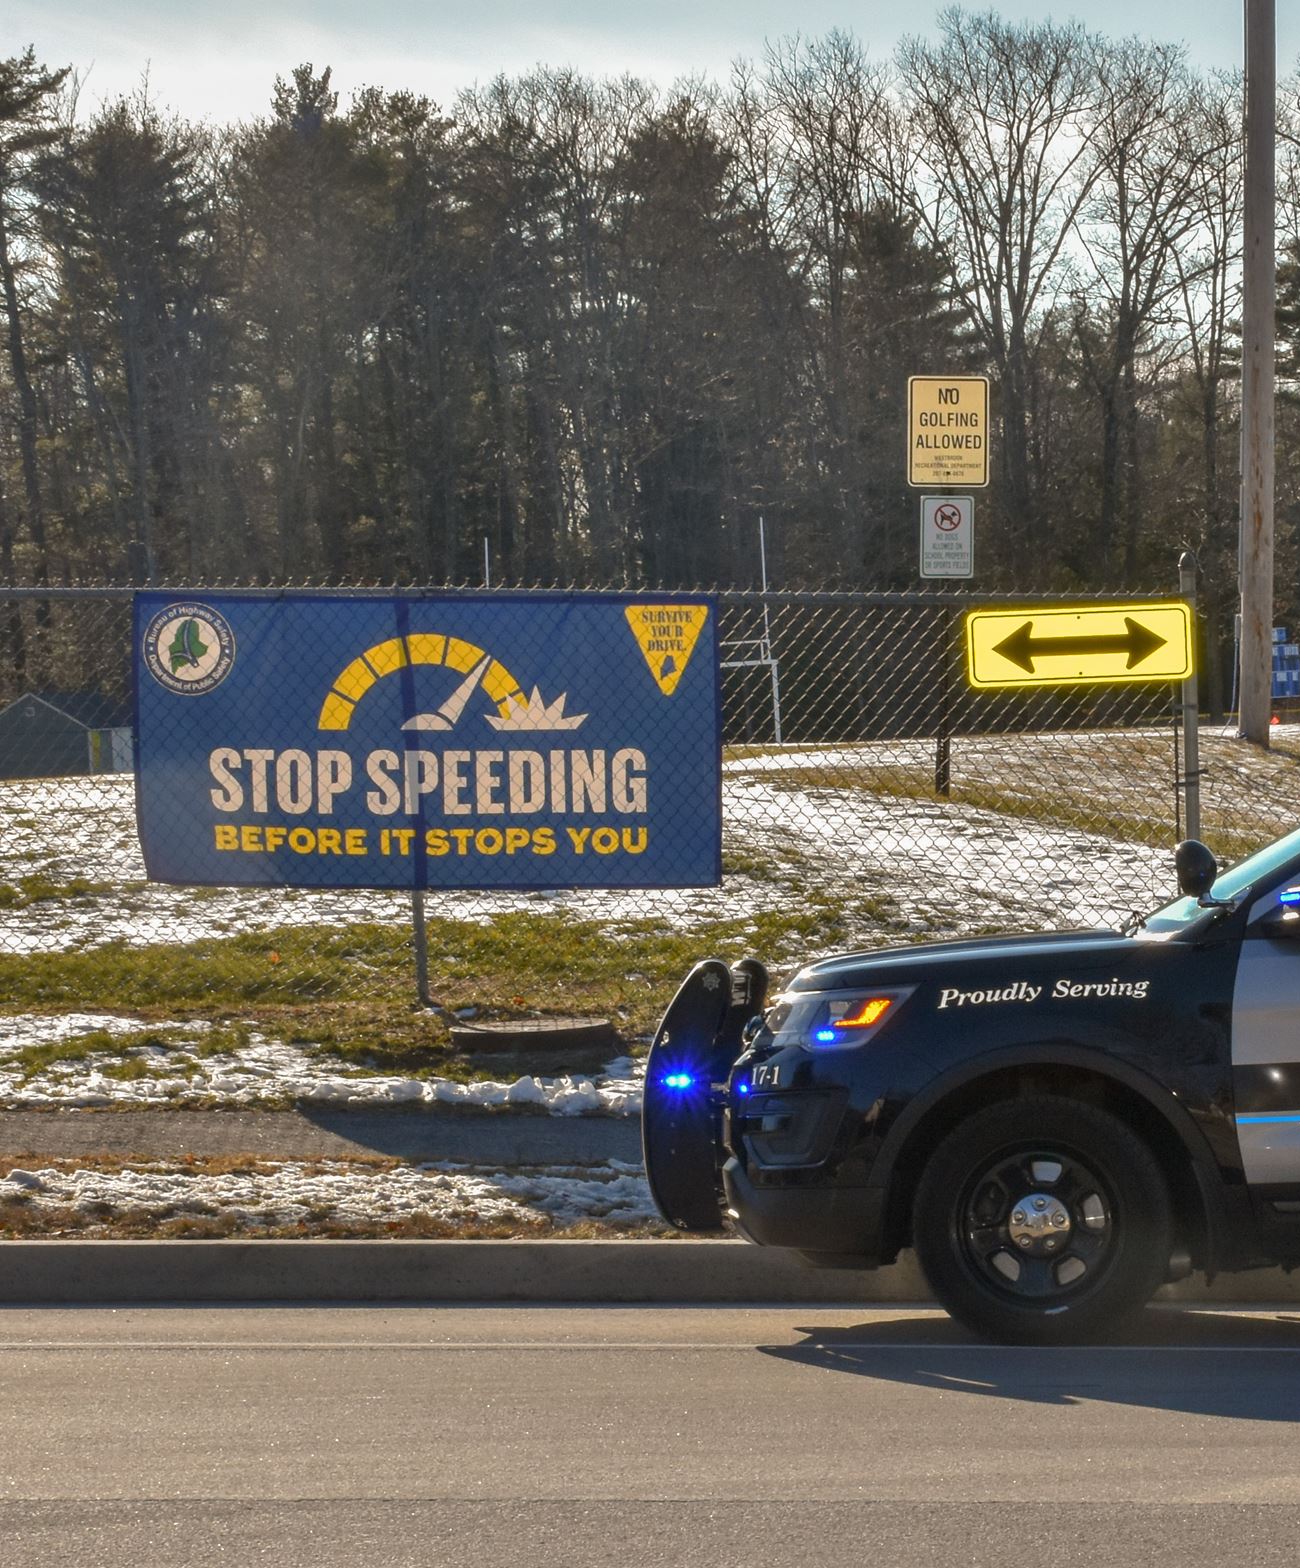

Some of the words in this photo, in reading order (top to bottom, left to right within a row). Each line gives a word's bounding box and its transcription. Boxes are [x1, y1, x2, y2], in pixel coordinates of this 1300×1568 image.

[938, 387, 960, 405] NO
[919, 412, 979, 428] GOLFING
[915, 434, 982, 450] ALLOWED
[147, 614, 168, 643] Bureau
[168, 608, 177, 617] of
[178, 606, 215, 621] Highway
[213, 619, 230, 646] Safety
[641, 610, 692, 623] SURVIVE
[651, 625, 683, 638] YOUR
[647, 639, 687, 652] DRIVE.
[192, 677, 214, 691] Public
[211, 656, 231, 680] Safety
[209, 747, 352, 814] STOP
[366, 748, 648, 816] SPEEDING
[214, 825, 368, 856] BEFORE
[380, 828, 416, 856] IT
[425, 827, 557, 856] STOPS
[565, 827, 648, 855] YOU
[937, 982, 1042, 1009] Proudly
[1052, 978, 1150, 999] Serving
[751, 1065, 780, 1086] 17-1
